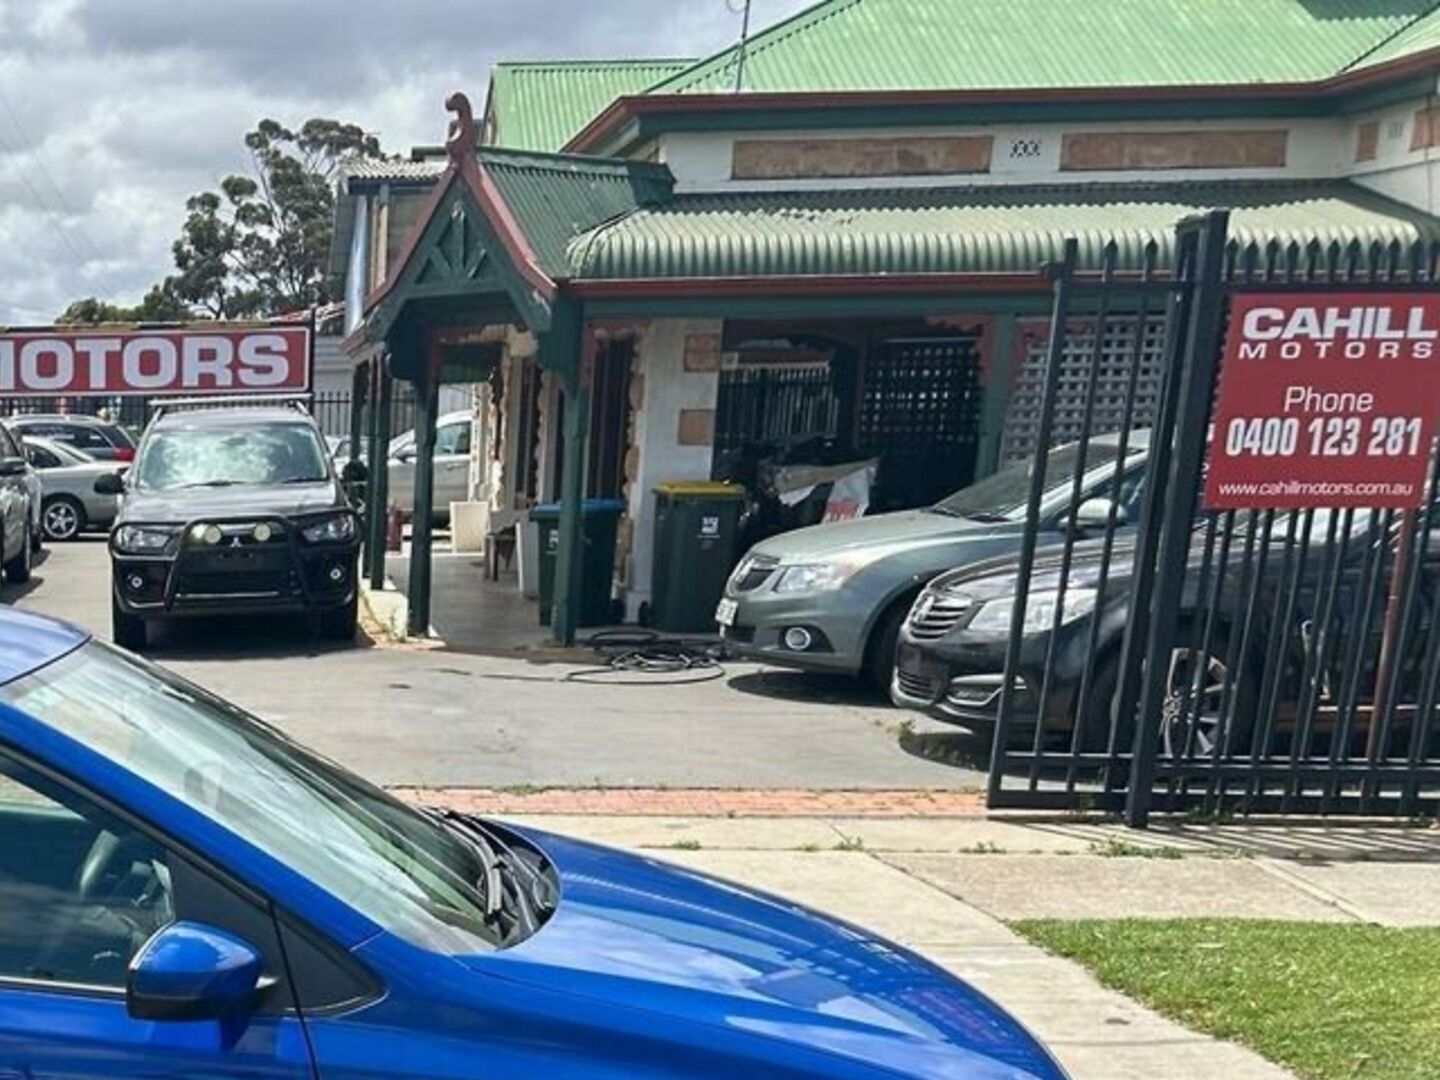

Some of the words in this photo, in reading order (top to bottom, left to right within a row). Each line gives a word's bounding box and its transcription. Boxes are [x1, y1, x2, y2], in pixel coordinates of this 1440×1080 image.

[1242, 307, 1438, 339] CAHILL
[1238, 342, 1433, 359] MOTORS
[1283, 386, 1373, 412] Phone
[1225, 417, 1300, 457] 0400
[1308, 417, 1361, 457] 123
[1367, 416, 1423, 456] 281
[1219, 480, 1413, 496] www.cahillmotors.com.au
